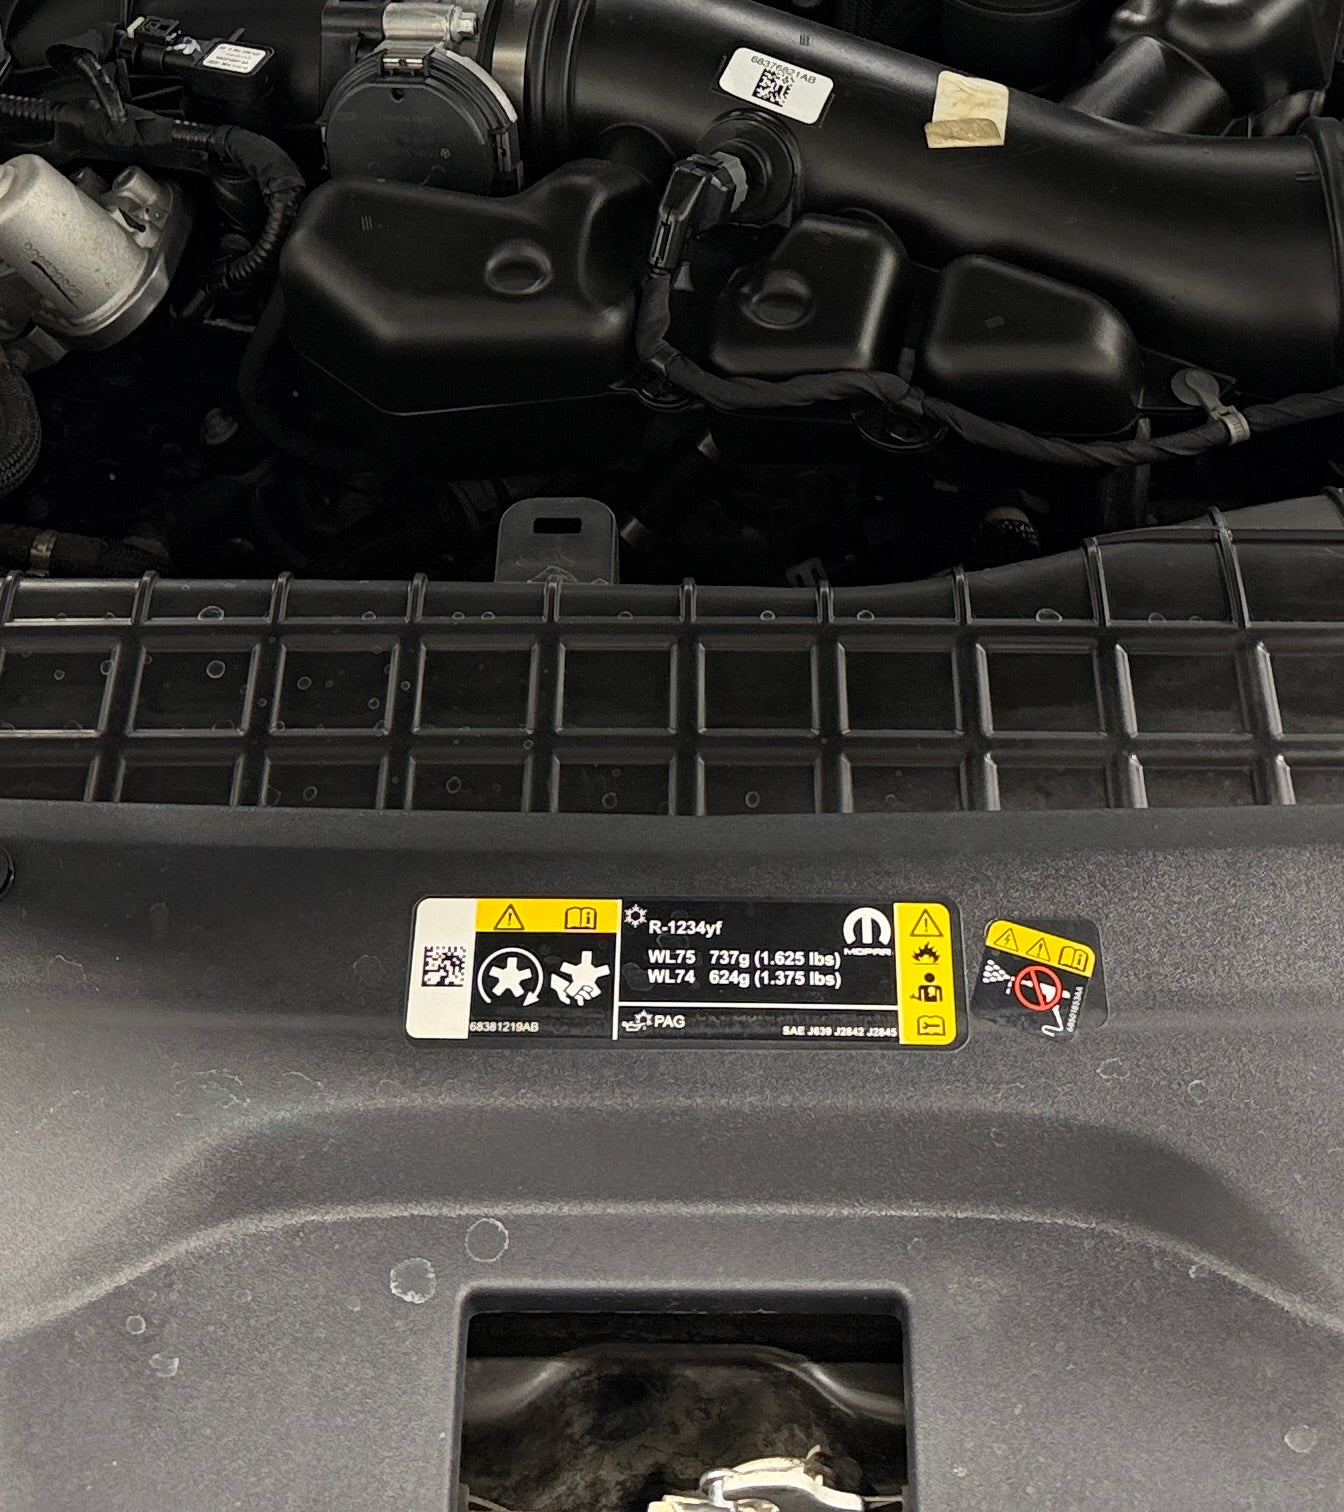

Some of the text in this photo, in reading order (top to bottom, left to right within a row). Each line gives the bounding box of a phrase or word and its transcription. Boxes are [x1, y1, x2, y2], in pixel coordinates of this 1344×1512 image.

[648, 920, 724, 938] R-1234yf
[647, 949, 841, 970] WL75 737g (1.625 lbs)
[843, 947, 892, 957] MOPAR
[647, 969, 842, 990] WL74 624g (1.375 lbs)
[654, 1015, 686, 1029] PAG
[782, 1025, 806, 1036] SAE
[806, 1026, 833, 1037] J639
